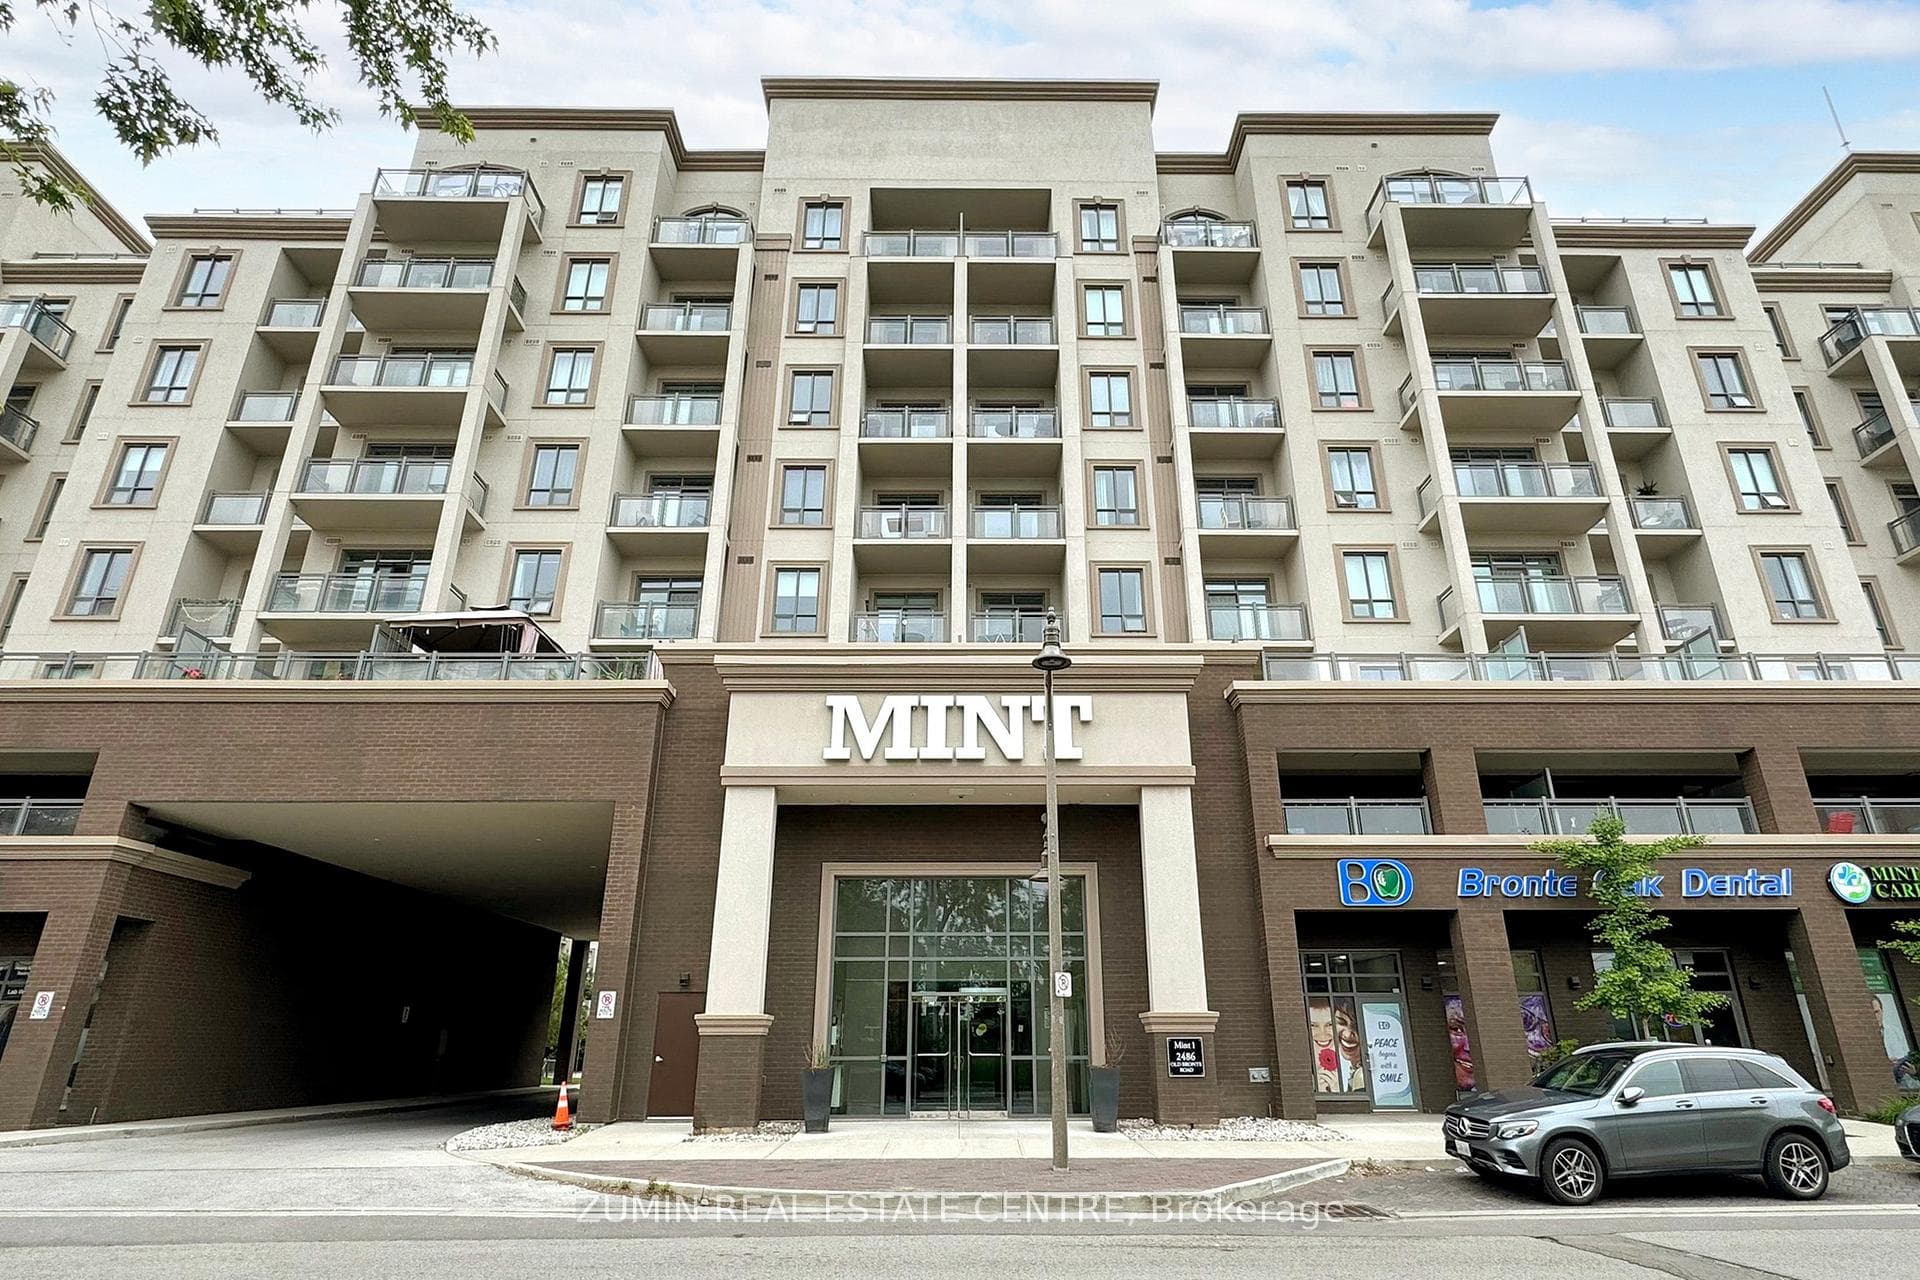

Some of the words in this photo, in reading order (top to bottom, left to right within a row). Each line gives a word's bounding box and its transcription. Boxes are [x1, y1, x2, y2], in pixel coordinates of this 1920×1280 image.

[822, 695, 1093, 760] MINT
[1870, 866, 1920, 881] MINT
[1457, 867, 1577, 898] Bronte
[1681, 867, 1793, 898] Dental
[1174, 1040, 1191, 1049] Mint
[1374, 1038, 1398, 1048] PEACE
[1176, 1051, 1196, 1061] 2486
[1379, 1073, 1403, 1083] SMILE
